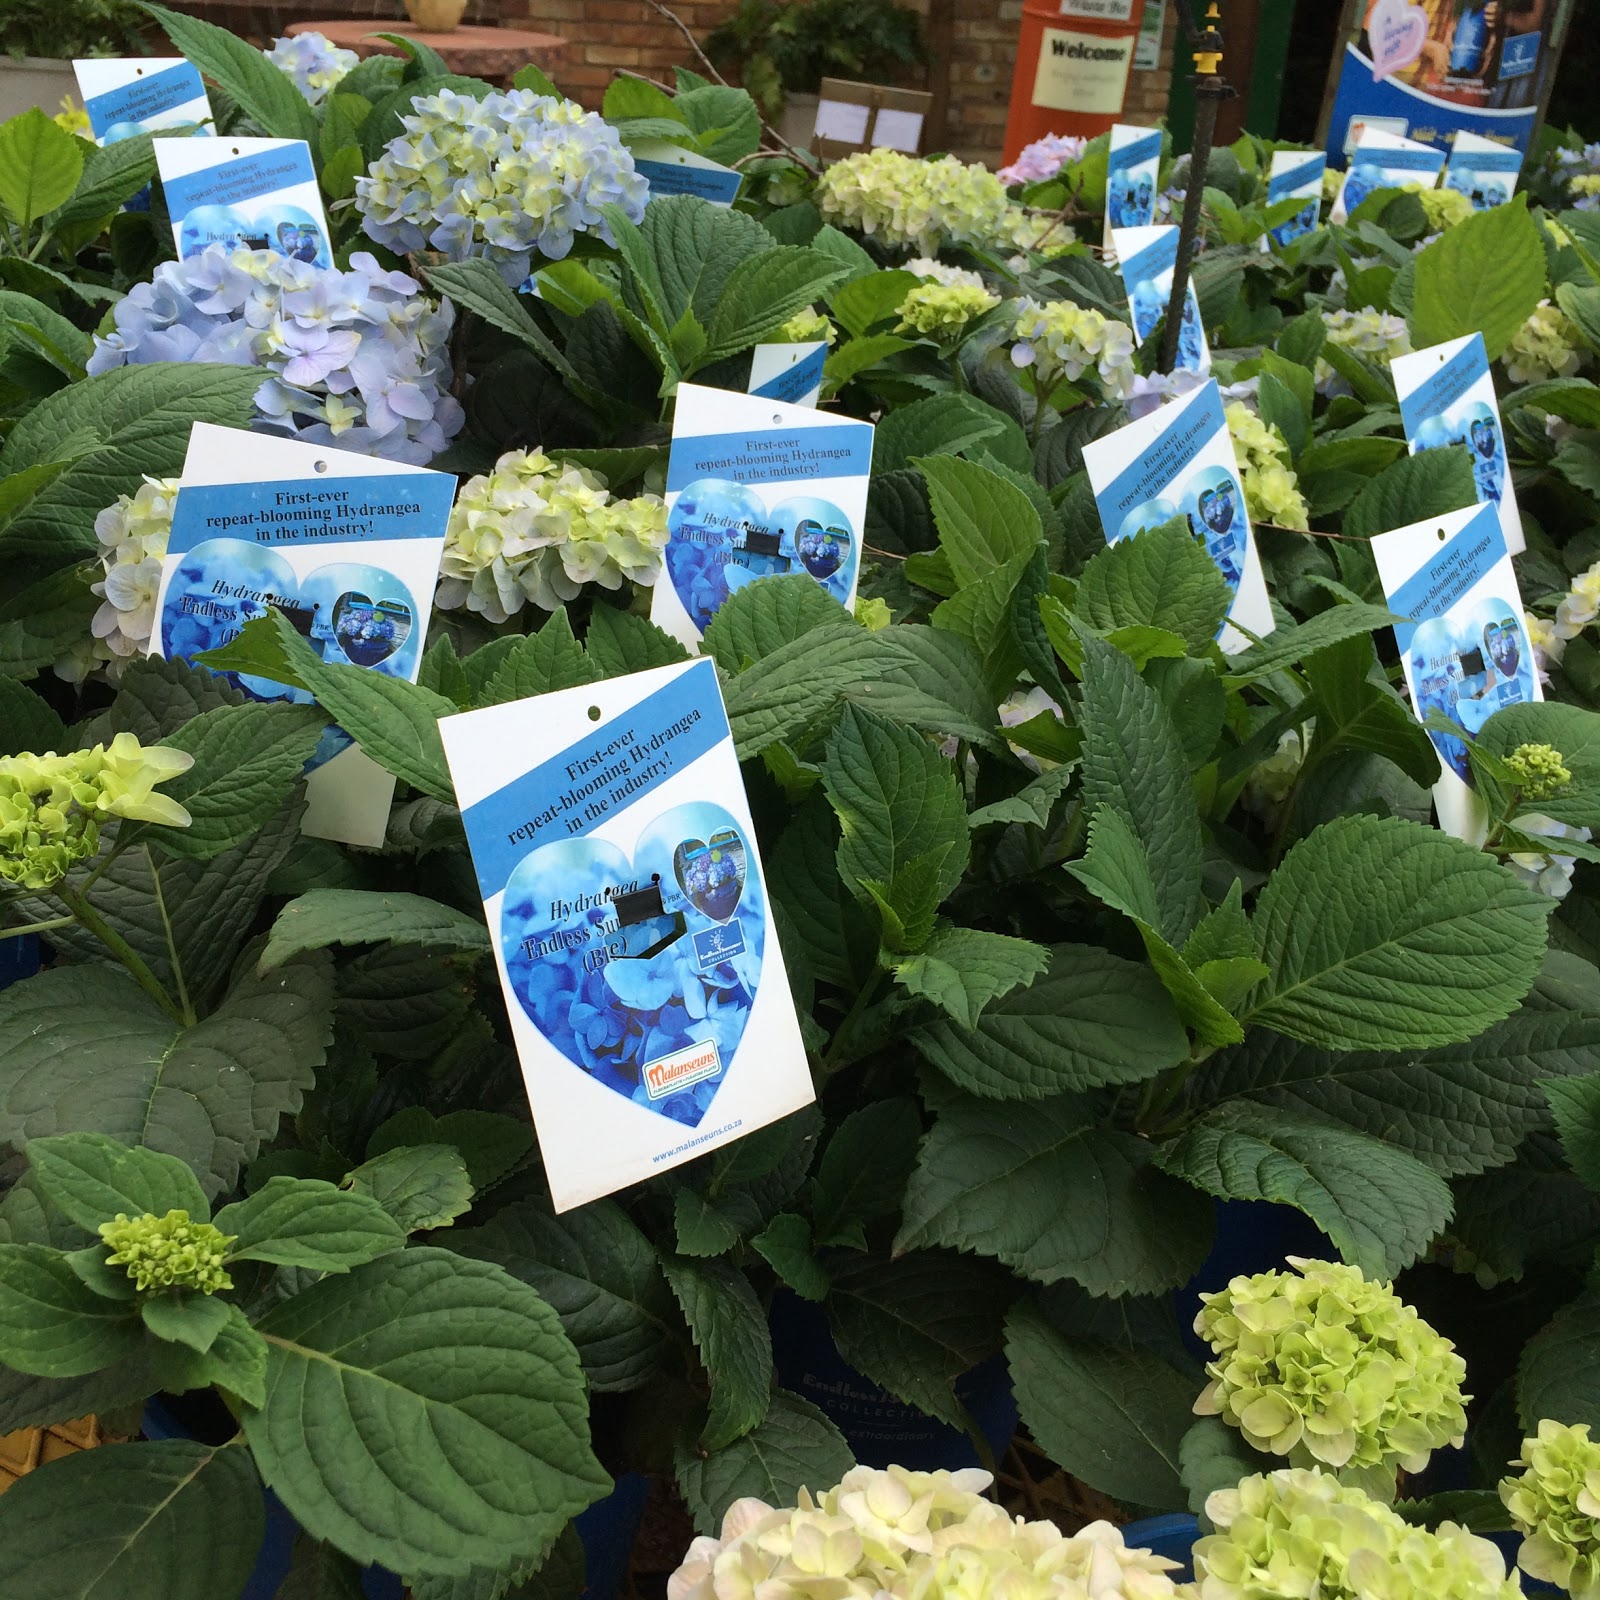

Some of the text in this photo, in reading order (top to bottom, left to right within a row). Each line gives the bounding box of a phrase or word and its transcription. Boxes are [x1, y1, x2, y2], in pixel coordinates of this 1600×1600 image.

[1052, 38, 1126, 61] Welcome
[695, 447, 852, 473] repeat-blooming Hydrangea
[746, 439, 800, 452] First-ever
[1118, 411, 1212, 511] repeat-blooming Hydrangea
[1143, 431, 1178, 469] First-ever
[733, 462, 820, 481] in the industry!
[1144, 440, 1198, 499] in the industry!
[275, 490, 350, 505] First-ever
[206, 502, 421, 528] repeat-blooming Hydrangea
[256, 520, 374, 541] in the industry!
[1408, 535, 1492, 620] repeat-blooming Hydrangea
[1430, 548, 1461, 581] First-ever
[1432, 562, 1480, 615] in the industry!
[179, 596, 238, 621] 'Endless
[564, 728, 636, 782] First-ever
[507, 708, 702, 846] repeat-blooming Hydrangea
[564, 751, 674, 835] in the industry!
[520, 927, 592, 961] 'Endless
[708, 950, 737, 964] COLLECTION
[649, 1052, 715, 1089] Malanseuns
[652, 1119, 743, 1163] www.malanseuns.co.za
[802, 1373, 877, 1402] Endless
[848, 1429, 938, 1441] extraordinary
